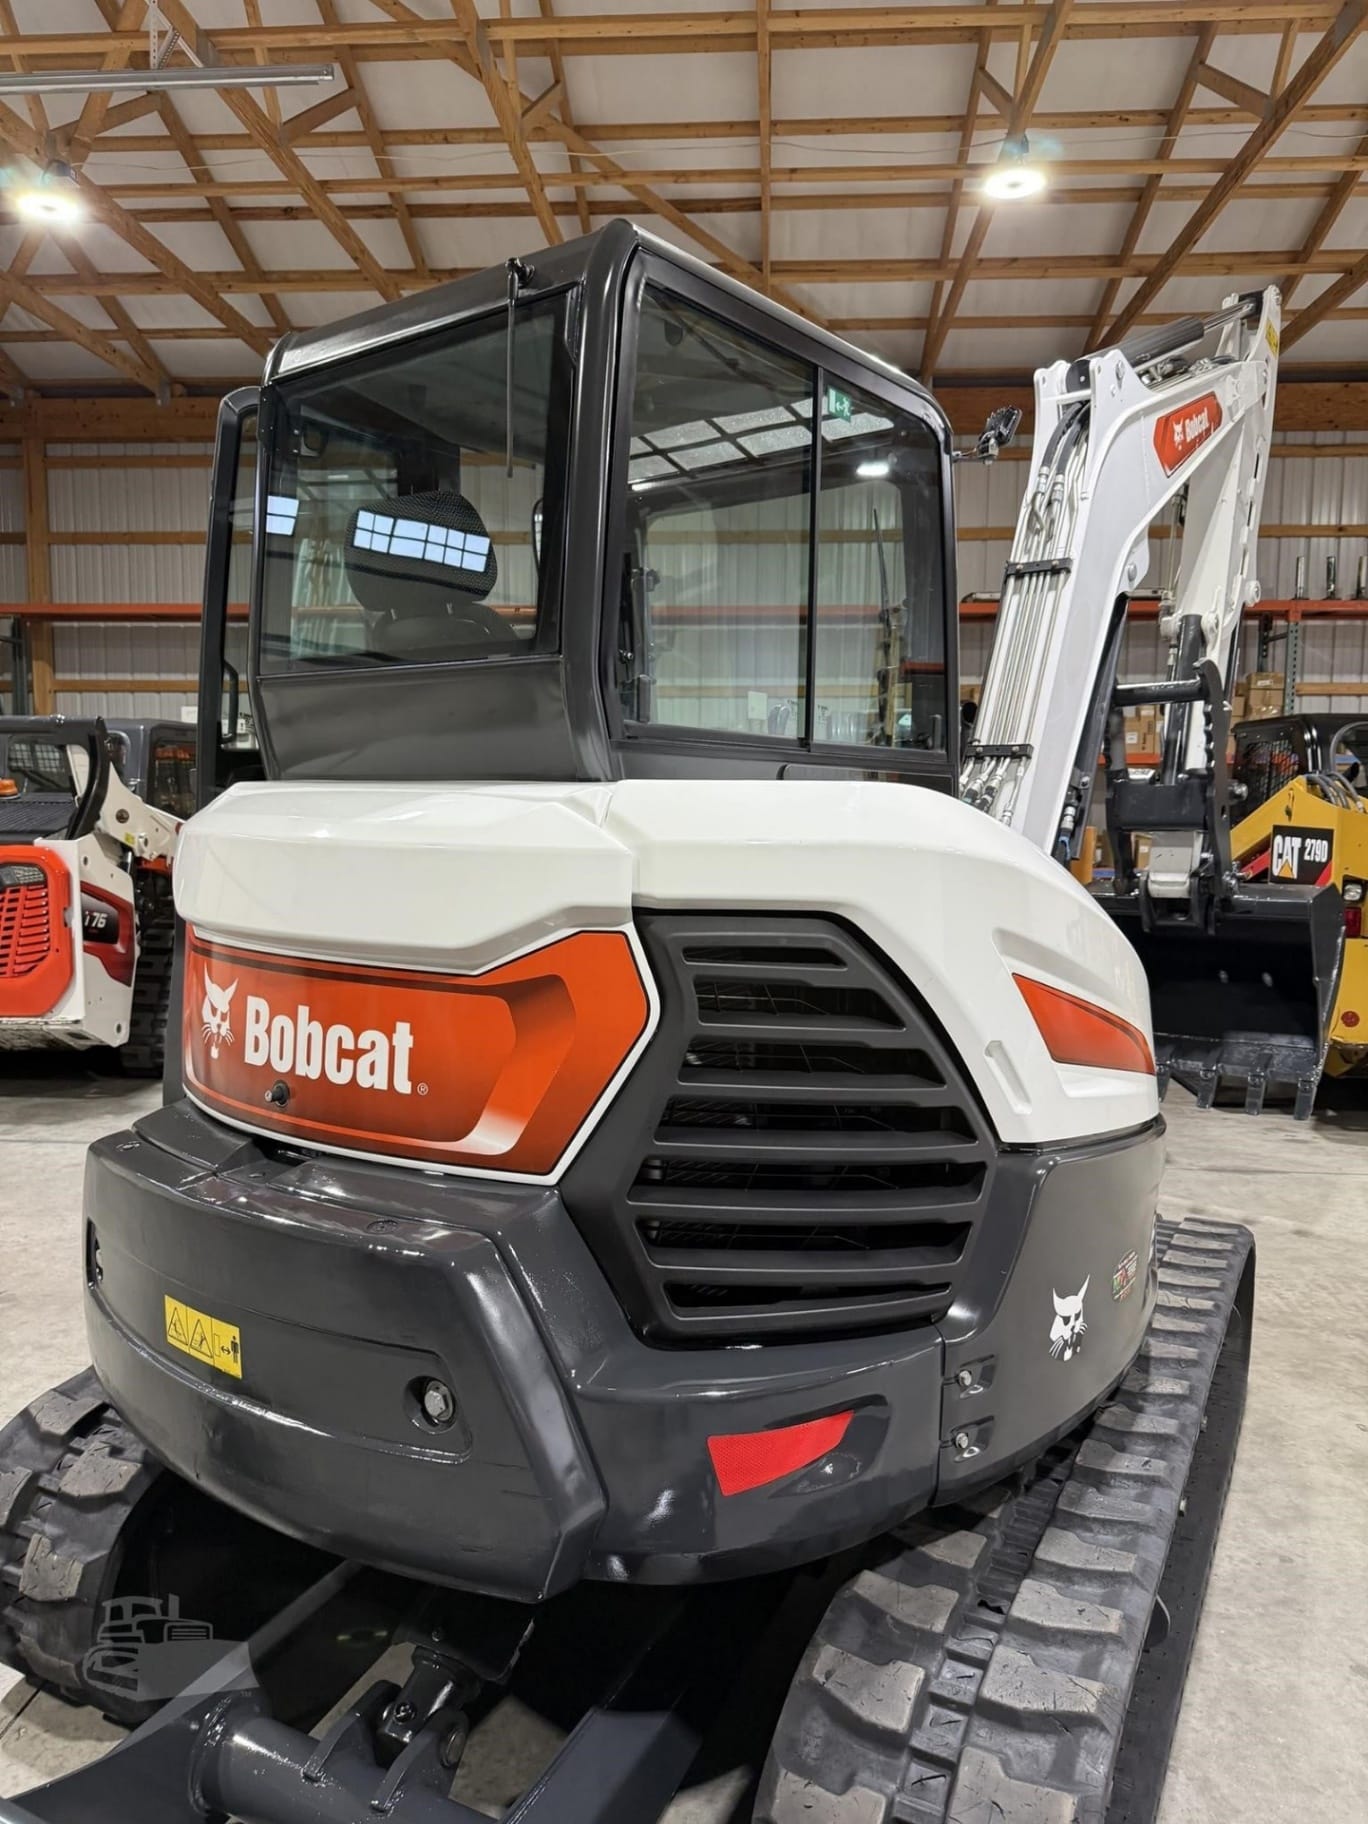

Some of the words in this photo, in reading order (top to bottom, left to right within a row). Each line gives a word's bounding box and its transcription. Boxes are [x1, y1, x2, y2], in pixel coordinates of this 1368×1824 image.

[1185, 407, 1209, 443] Bobcat
[1272, 834, 1302, 879] CAT
[1303, 837, 1329, 863] 279D
[244, 995, 414, 1095] Bobcat
